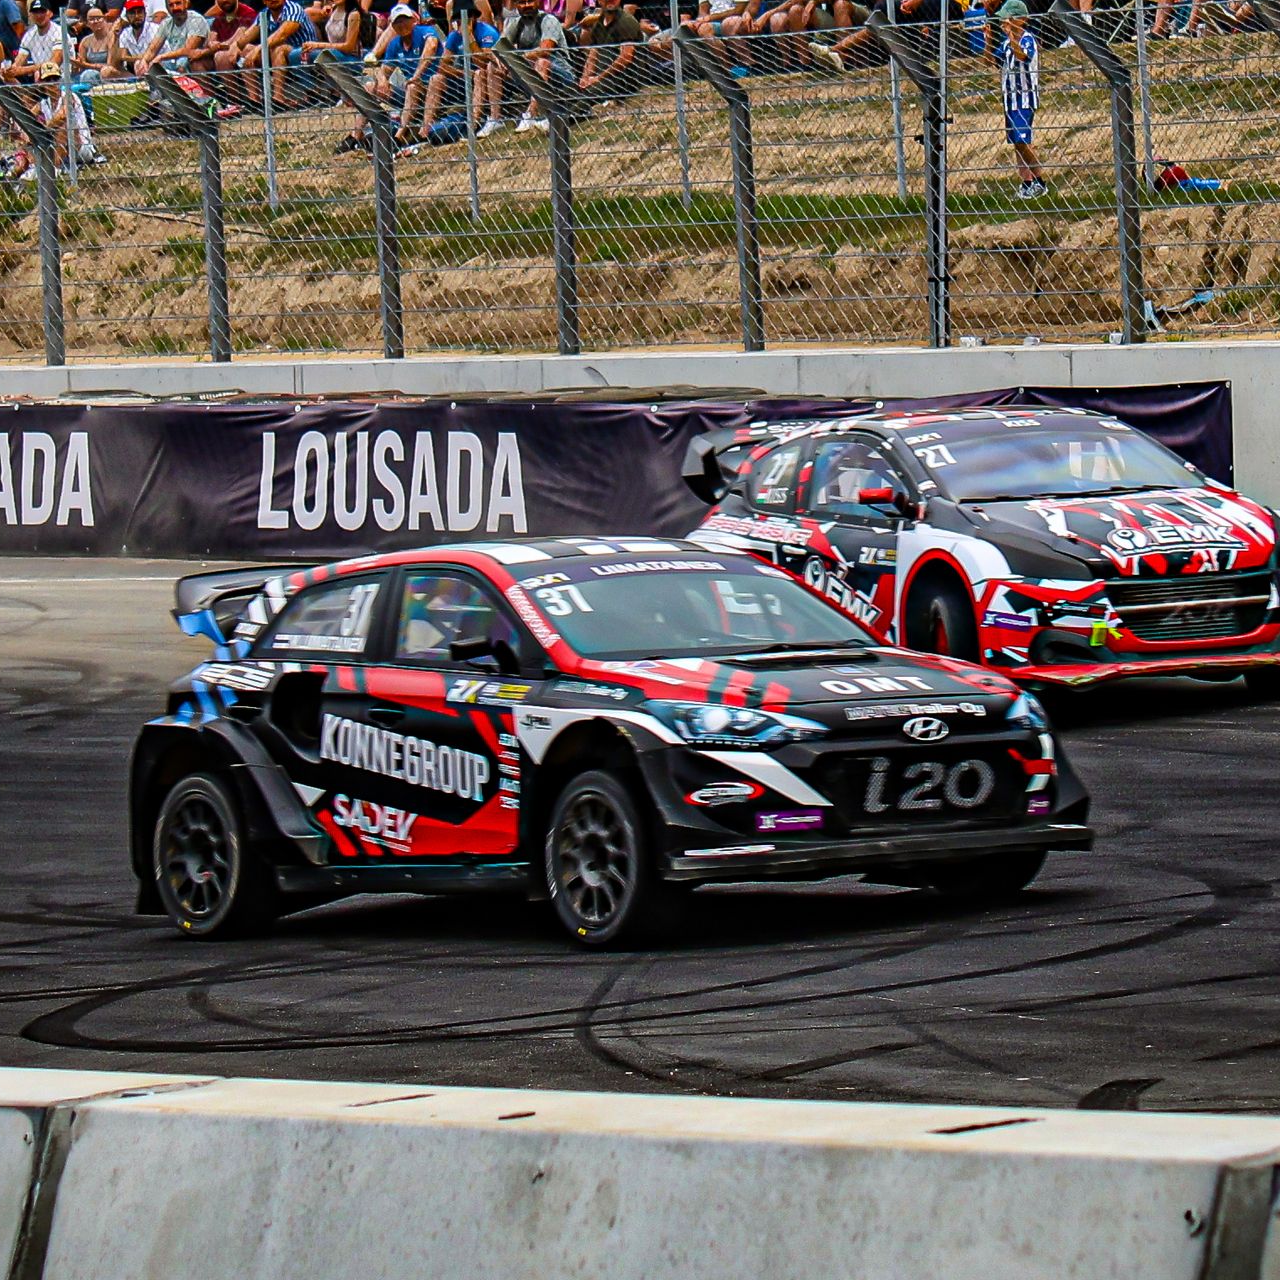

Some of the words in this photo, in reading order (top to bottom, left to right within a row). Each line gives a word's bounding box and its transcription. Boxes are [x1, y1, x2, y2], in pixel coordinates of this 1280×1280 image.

[763, 447, 799, 486] 27
[914, 445, 958, 468] 27
[257, 430, 528, 533] LOUSADA
[341, 583, 380, 636] 37
[535, 585, 594, 616] 37
[820, 676, 933, 695] OMT
[321, 713, 490, 802] KONNEGROUP
[864, 756, 995, 814] i20
[333, 793, 418, 840] SADEV
